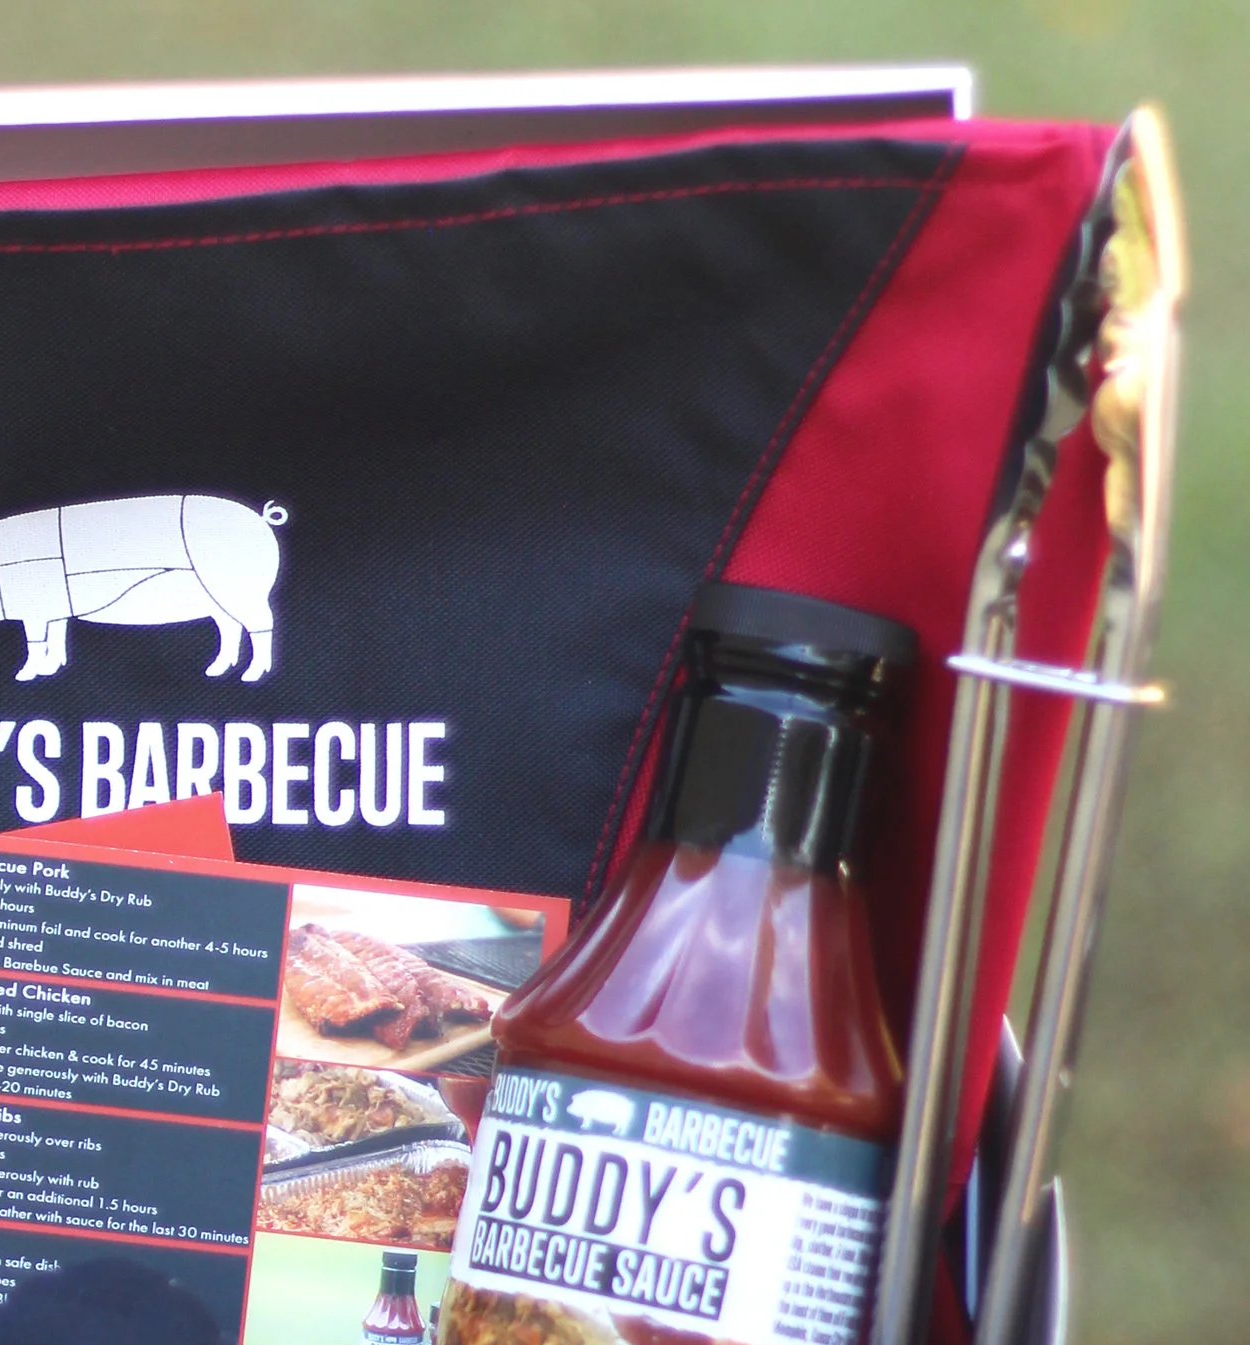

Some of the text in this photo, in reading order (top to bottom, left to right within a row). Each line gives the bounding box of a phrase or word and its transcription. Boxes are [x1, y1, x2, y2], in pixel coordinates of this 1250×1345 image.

[82, 721, 446, 826] BARBECUE
[32, 860, 70, 879] Pork
[0, 897, 35, 913] hours
[14, 881, 41, 895] with
[44, 883, 97, 903] Buddy's
[100, 889, 124, 907] Dry
[127, 892, 152, 907] Rub
[7, 937, 44, 952] shred
[40, 920, 62, 935] foil
[63, 926, 91, 938] and
[93, 929, 126, 942] cook
[150, 936, 201, 951] another
[204, 940, 229, 954] 4-5
[232, 942, 268, 958] hours
[3, 956, 58, 974] Barebue
[61, 962, 103, 979] Sauce
[105, 969, 132, 982] and
[134, 972, 158, 985] mix
[176, 979, 209, 990] meat
[22, 984, 91, 1006] Chicken
[16, 1006, 54, 1023] single
[57, 1009, 86, 1024] slice
[106, 1014, 148, 1031] bacon
[14, 1043, 64, 1060] chicken
[81, 1052, 114, 1066] cook
[161, 1061, 211, 1077] minutes
[6, 1065, 79, 1084] generously
[81, 1071, 108, 1084] with
[112, 1073, 164, 1092] Buddy's
[167, 1079, 192, 1096] Dry
[195, 1082, 220, 1097] Rub
[23, 1084, 72, 1099] minutes
[491, 1073, 792, 1172] BUDDY'S BARBECUE
[44, 1137, 75, 1148] over
[77, 1137, 102, 1151] ribs
[47, 1173, 74, 1186] with
[77, 1176, 99, 1189] rub
[26, 1189, 94, 1208] additional
[99, 1196, 118, 1210] 1.5
[122, 1199, 158, 1215] hours
[480, 1130, 747, 1264] BUDDY'S
[35, 1210, 62, 1223] with
[65, 1216, 104, 1228] sauce
[106, 1216, 126, 1230] for
[128, 1219, 148, 1233] the
[151, 1221, 175, 1236] last
[200, 1229, 249, 1244] minutes
[471, 1220, 609, 1290] BARBECUE
[612, 1252, 727, 1316] SAUCE
